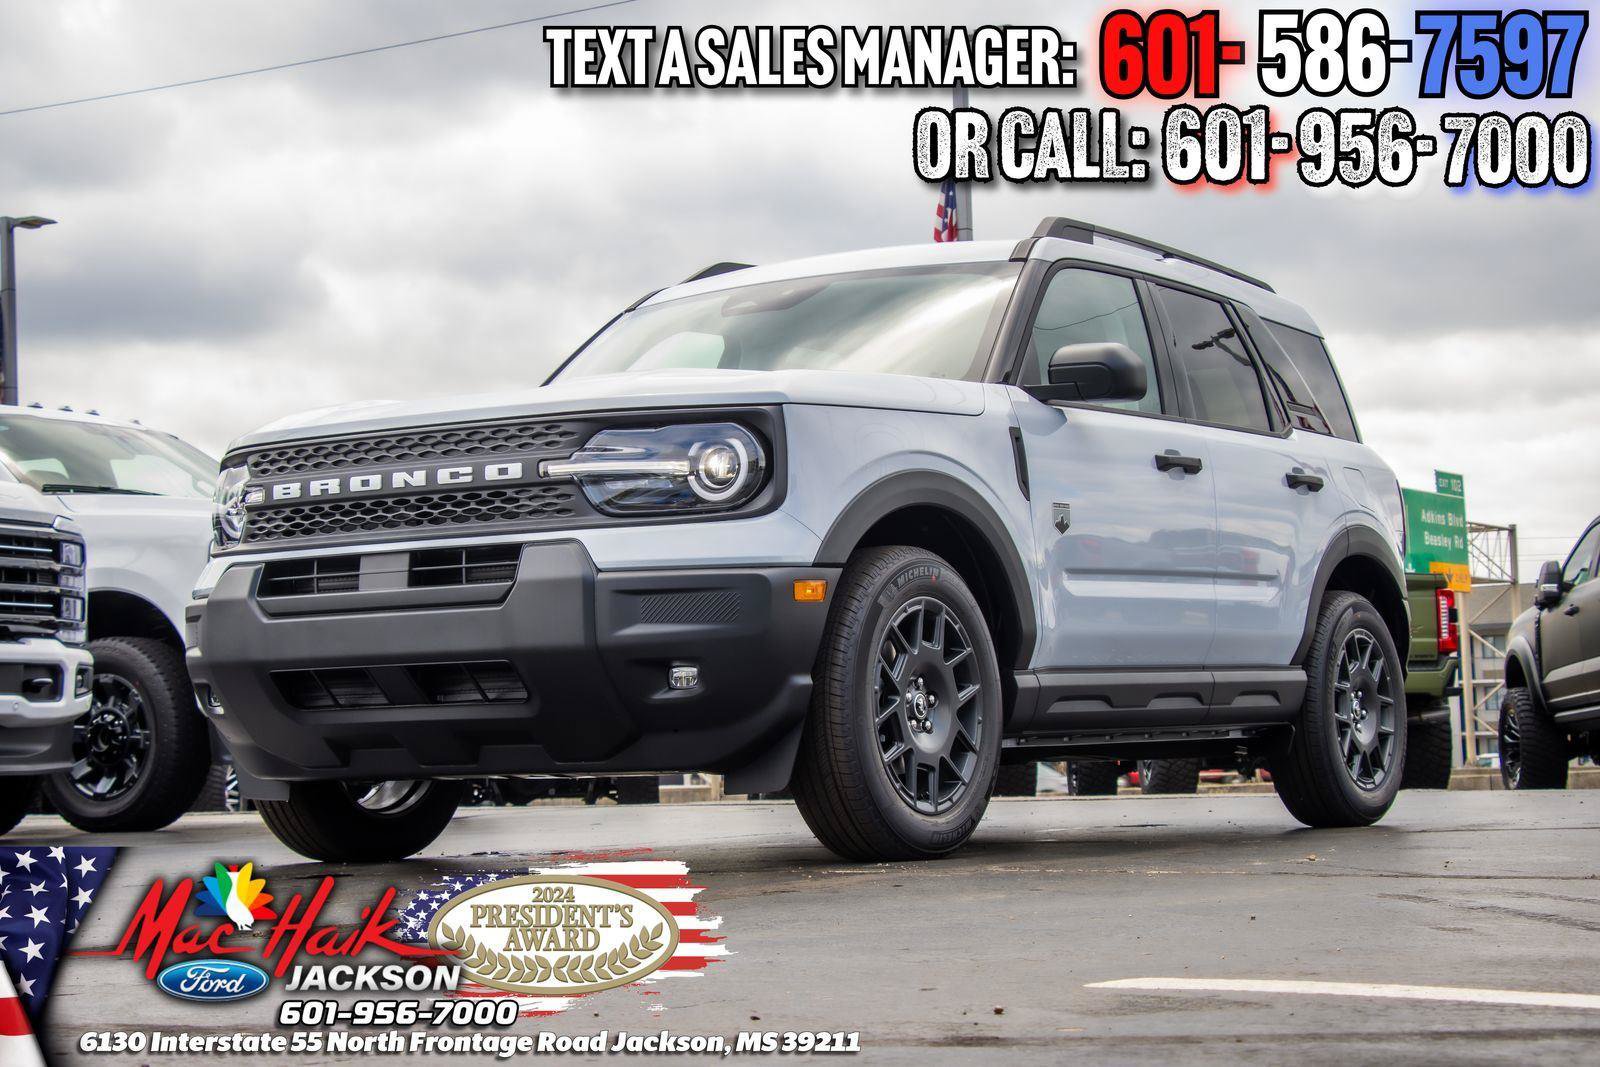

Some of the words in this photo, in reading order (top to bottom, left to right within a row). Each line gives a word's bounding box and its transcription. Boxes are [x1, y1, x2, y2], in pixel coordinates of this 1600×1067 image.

[273, 462, 522, 500] BRONCO
[1438, 478, 1449, 489] EXIT
[1450, 479, 1462, 492] 102
[1421, 509, 1446, 526] Adkins
[1447, 512, 1464, 528] Blvd
[1424, 531, 1452, 551] Beasley
[1454, 535, 1464, 549] Rd
[897, 566, 940, 589] MICHELIN
